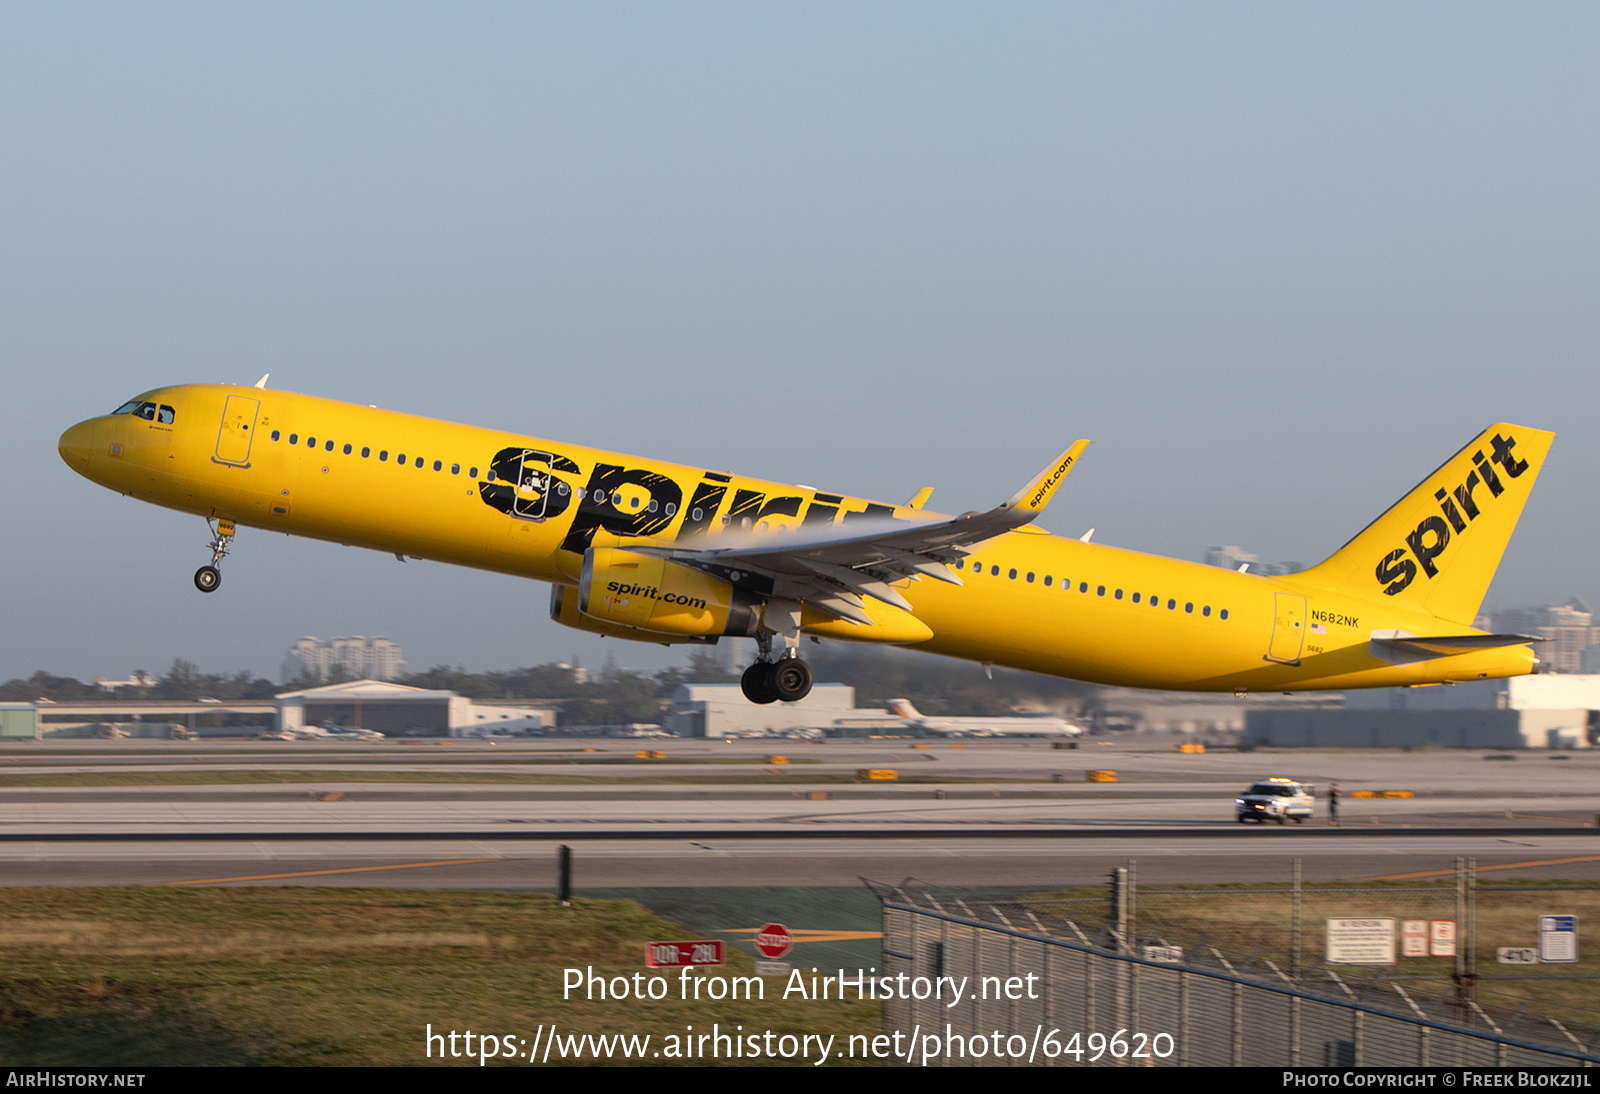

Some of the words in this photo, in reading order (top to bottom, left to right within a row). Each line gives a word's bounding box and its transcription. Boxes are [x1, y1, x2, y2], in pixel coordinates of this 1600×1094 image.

[1030, 456, 1073, 508] spirit.com
[1375, 433, 1530, 596] spirit
[606, 581, 707, 609] spirit.com
[1311, 609, 1360, 628] N682NK
[1306, 644, 1324, 654] 5682
[756, 932, 792, 948] STOP
